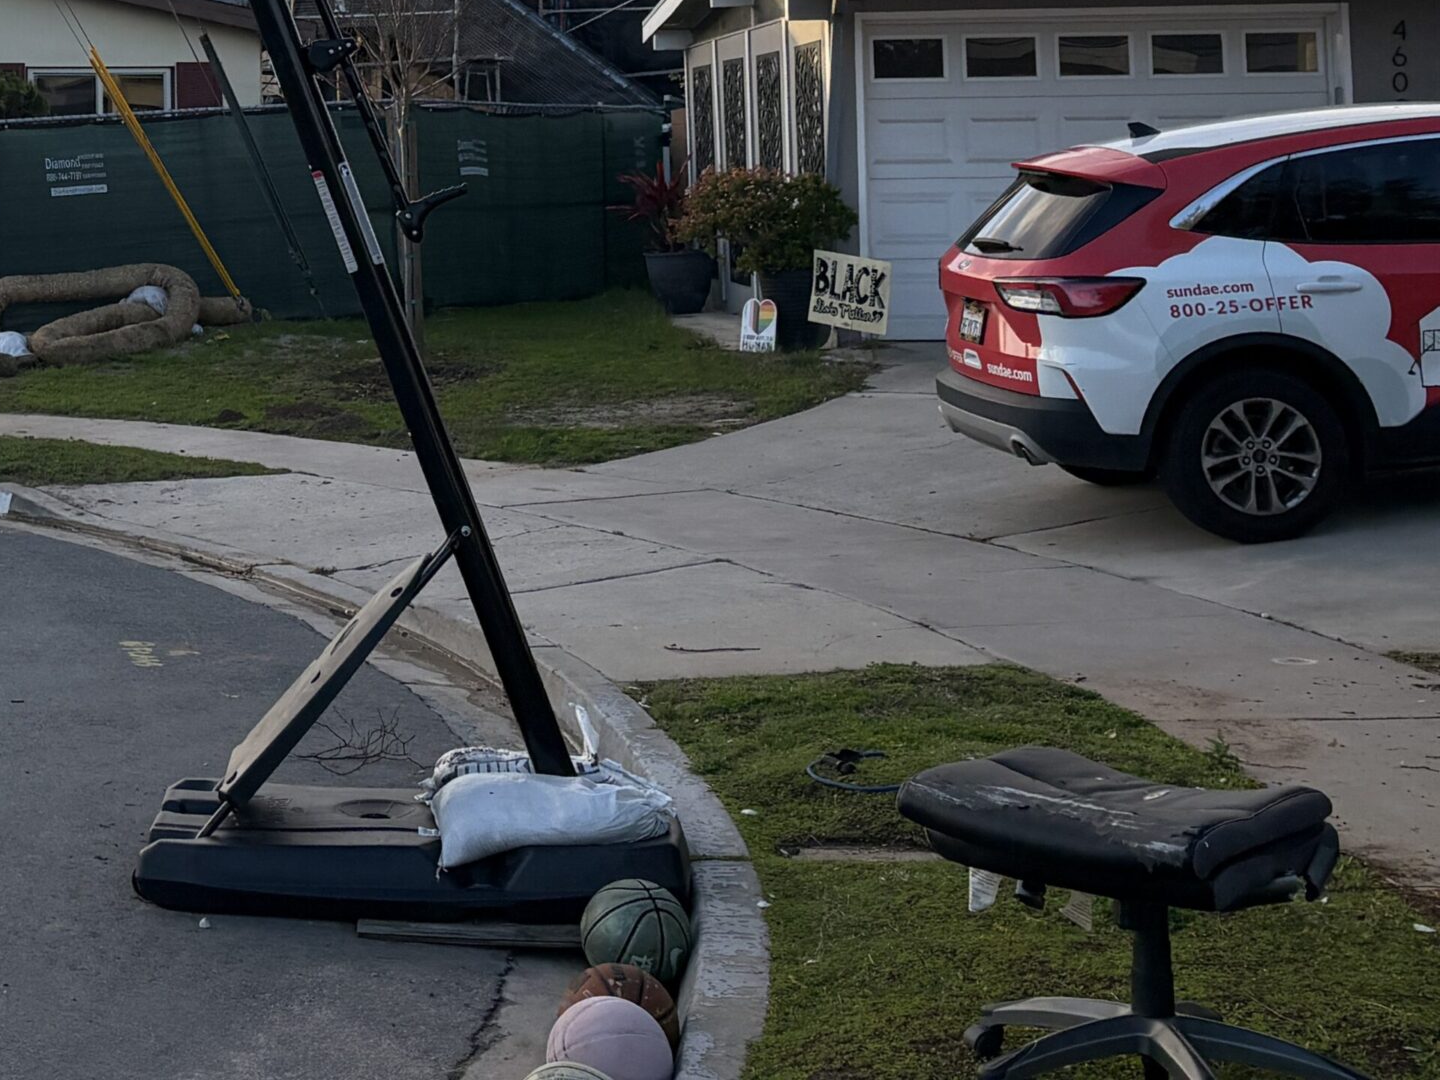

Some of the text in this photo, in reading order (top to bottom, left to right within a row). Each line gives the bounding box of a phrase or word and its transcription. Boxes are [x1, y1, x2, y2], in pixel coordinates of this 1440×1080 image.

[1392, 19, 1408, 102] 460
[45, 155, 81, 170] Diamond
[814, 257, 887, 310] BLACK
[1166, 282, 1255, 299] sundae.com
[1169, 294, 1314, 319] 800-25-OFFER
[986, 362, 1033, 383] sundae.com
